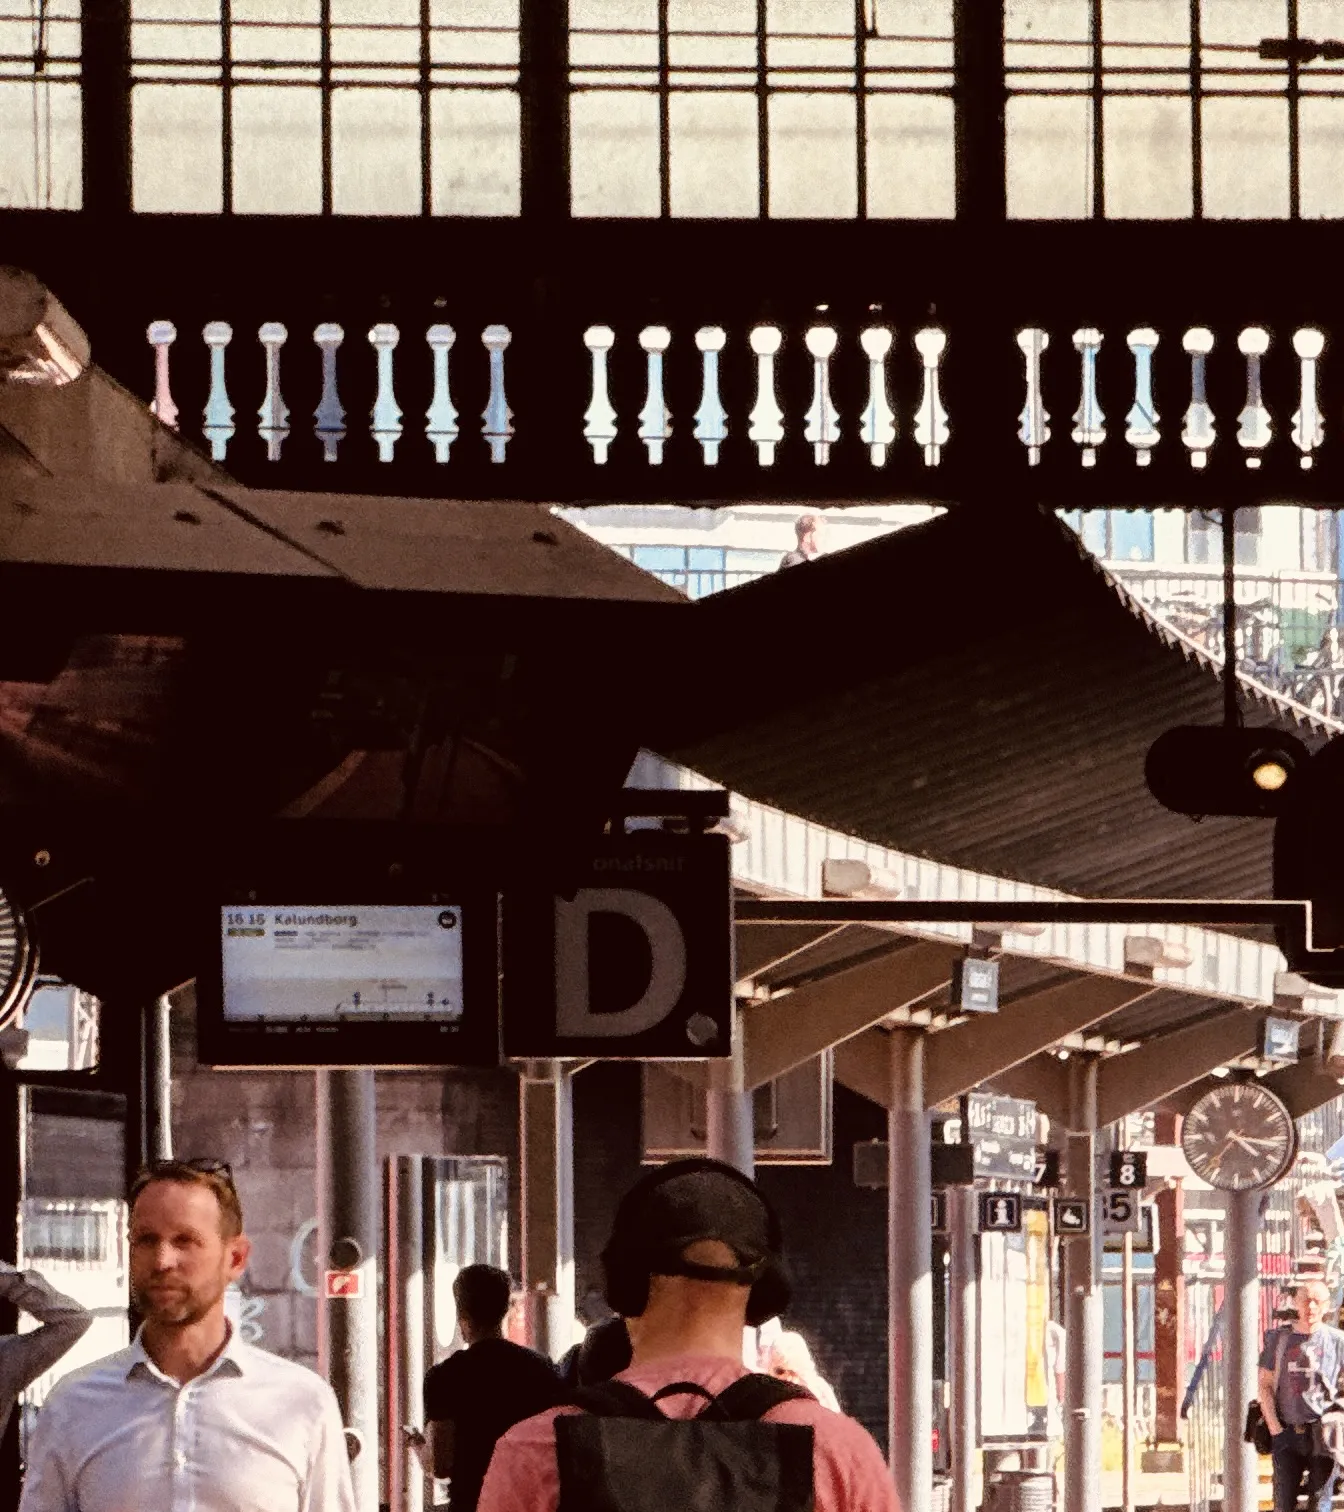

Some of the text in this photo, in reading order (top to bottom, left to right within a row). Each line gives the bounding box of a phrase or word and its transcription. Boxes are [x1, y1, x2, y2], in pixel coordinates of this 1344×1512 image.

[274, 914, 357, 927] Kalundborg
[555, 888, 687, 1037] D
[1120, 1165, 1135, 1185] 8
